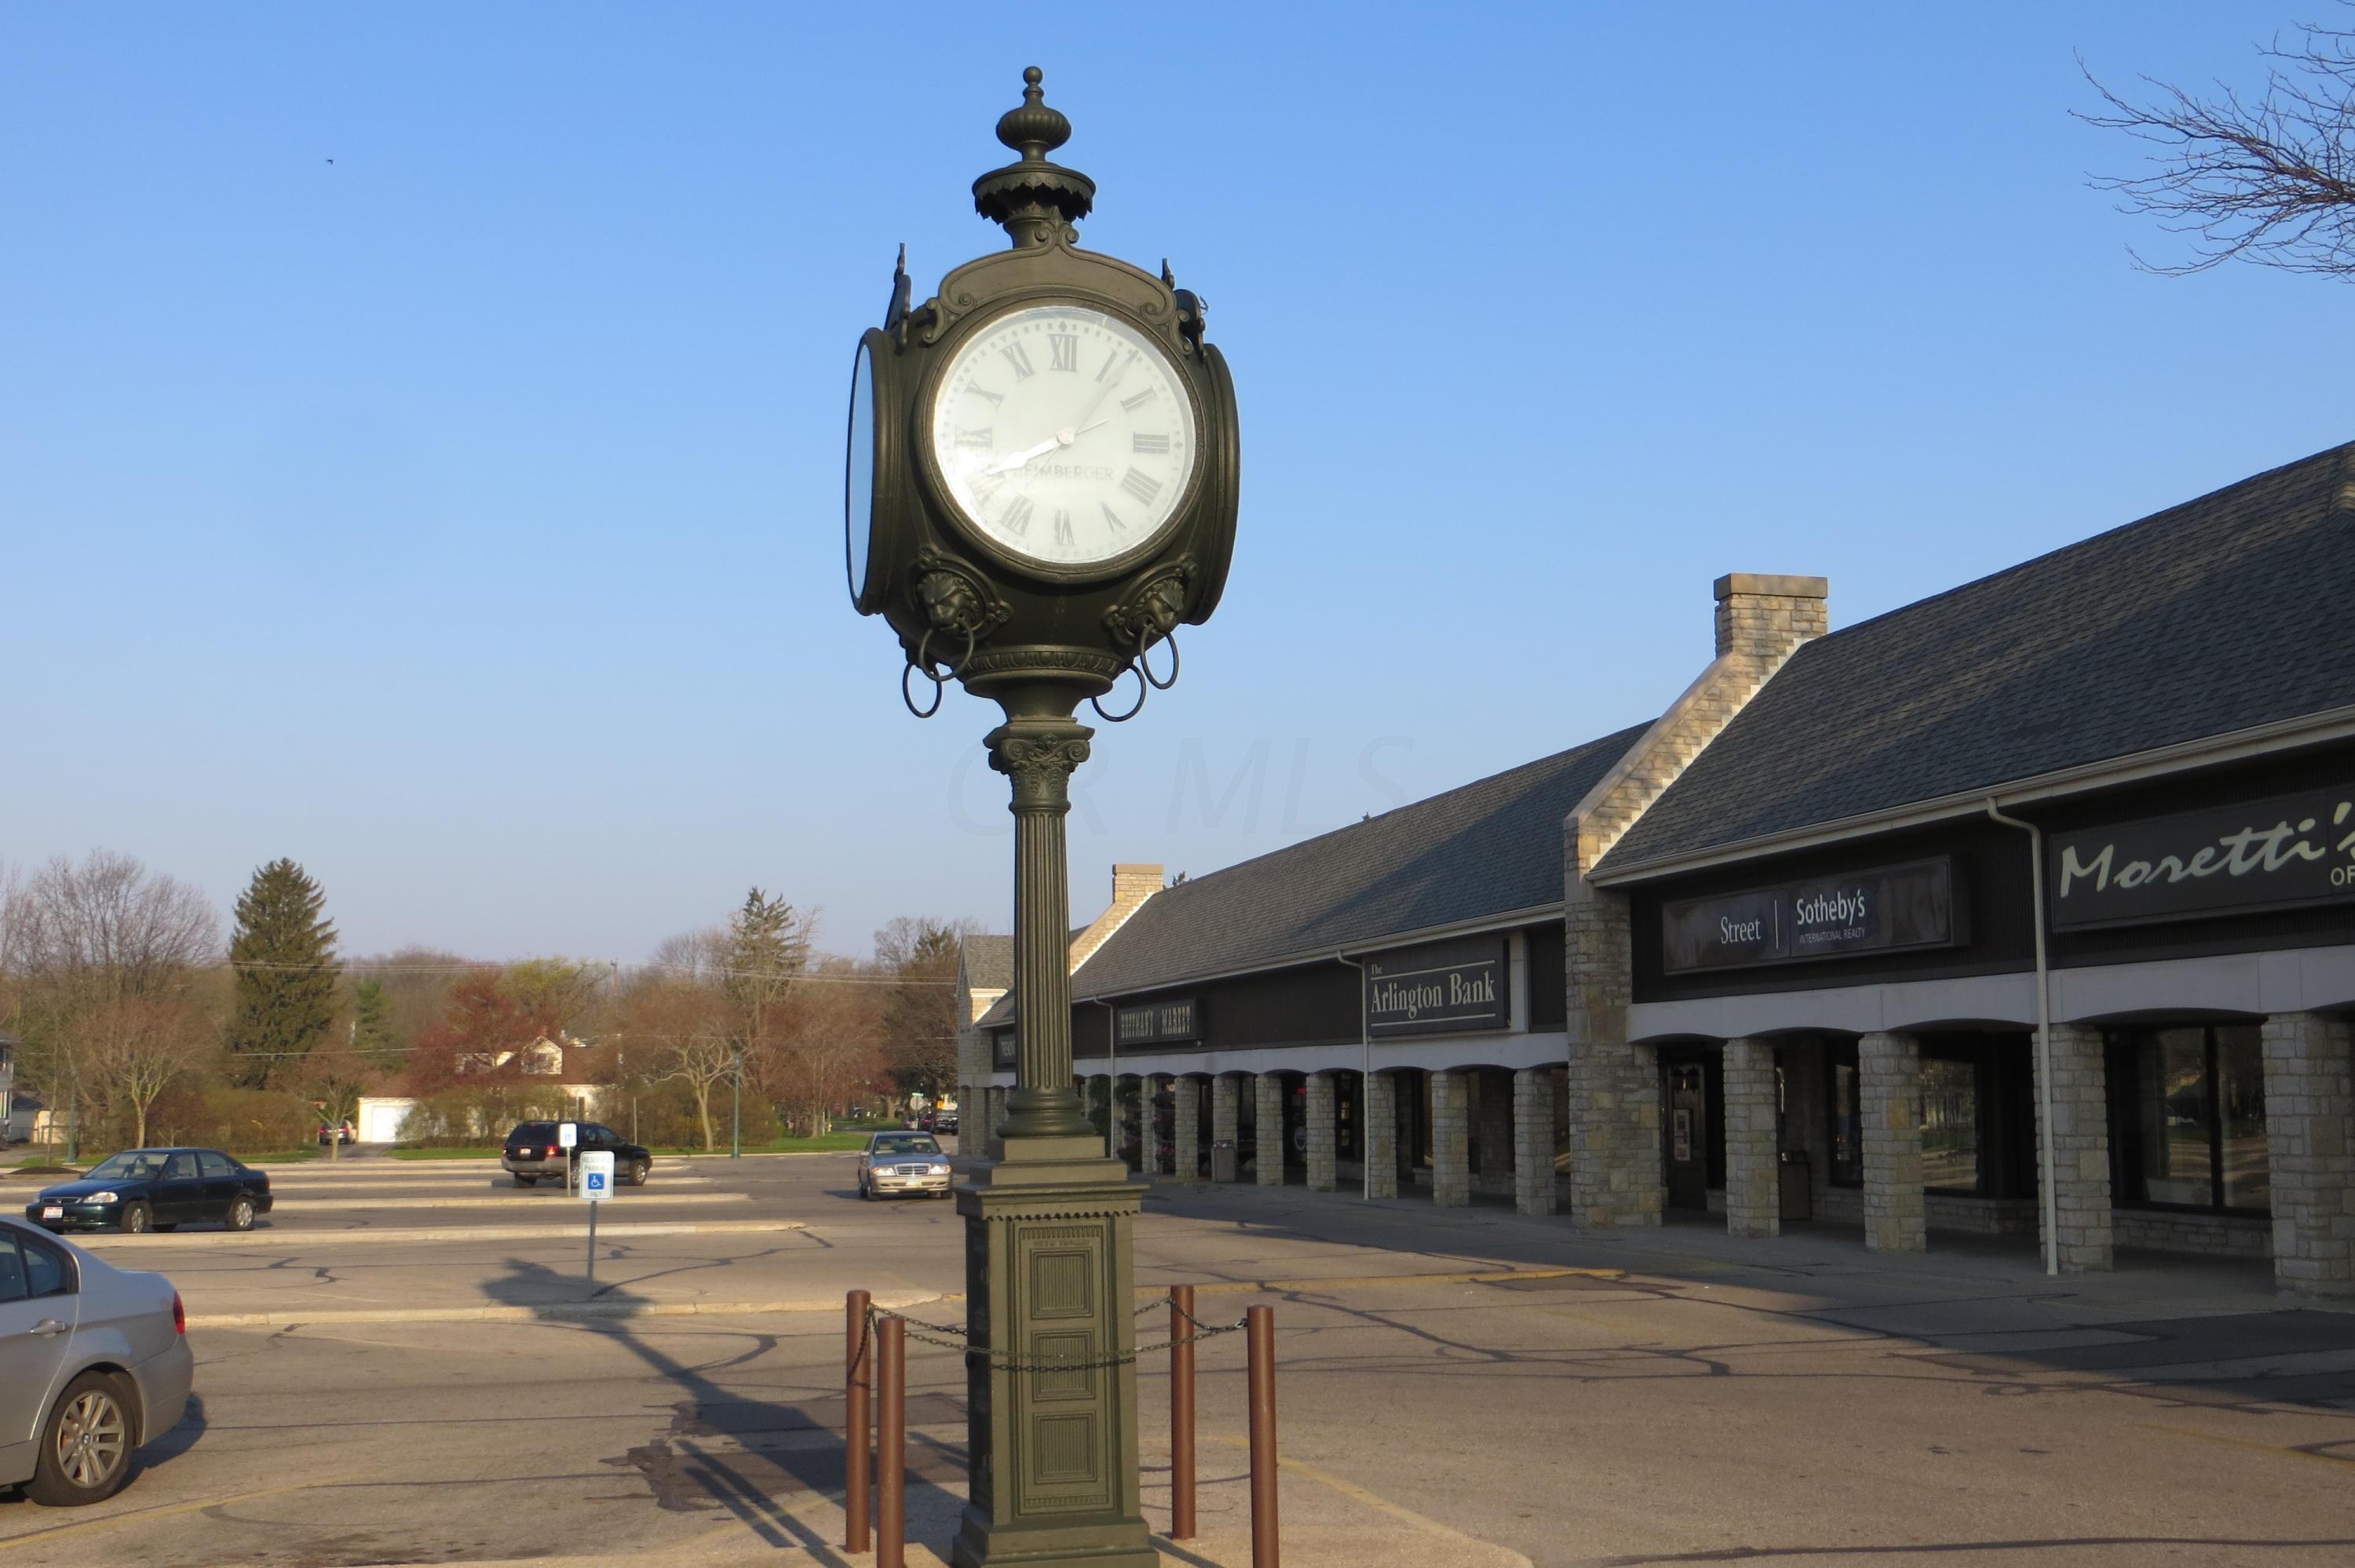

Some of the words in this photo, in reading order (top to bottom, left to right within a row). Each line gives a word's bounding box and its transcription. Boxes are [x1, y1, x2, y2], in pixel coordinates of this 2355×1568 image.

[1047, 334, 1079, 371] XII
[1134, 432, 1168, 452] III
[1719, 916, 1762, 945] Street
[1795, 888, 1866, 926] Sotheby's
[1798, 930, 1843, 944] INTERNATIONAL
[1843, 927, 1866, 940] REALTY
[1371, 964, 1383, 975] The
[1371, 981, 1444, 1019] Arlington
[1448, 970, 1495, 1006] Bank
[1162, 1005, 1191, 1035] MARKET
